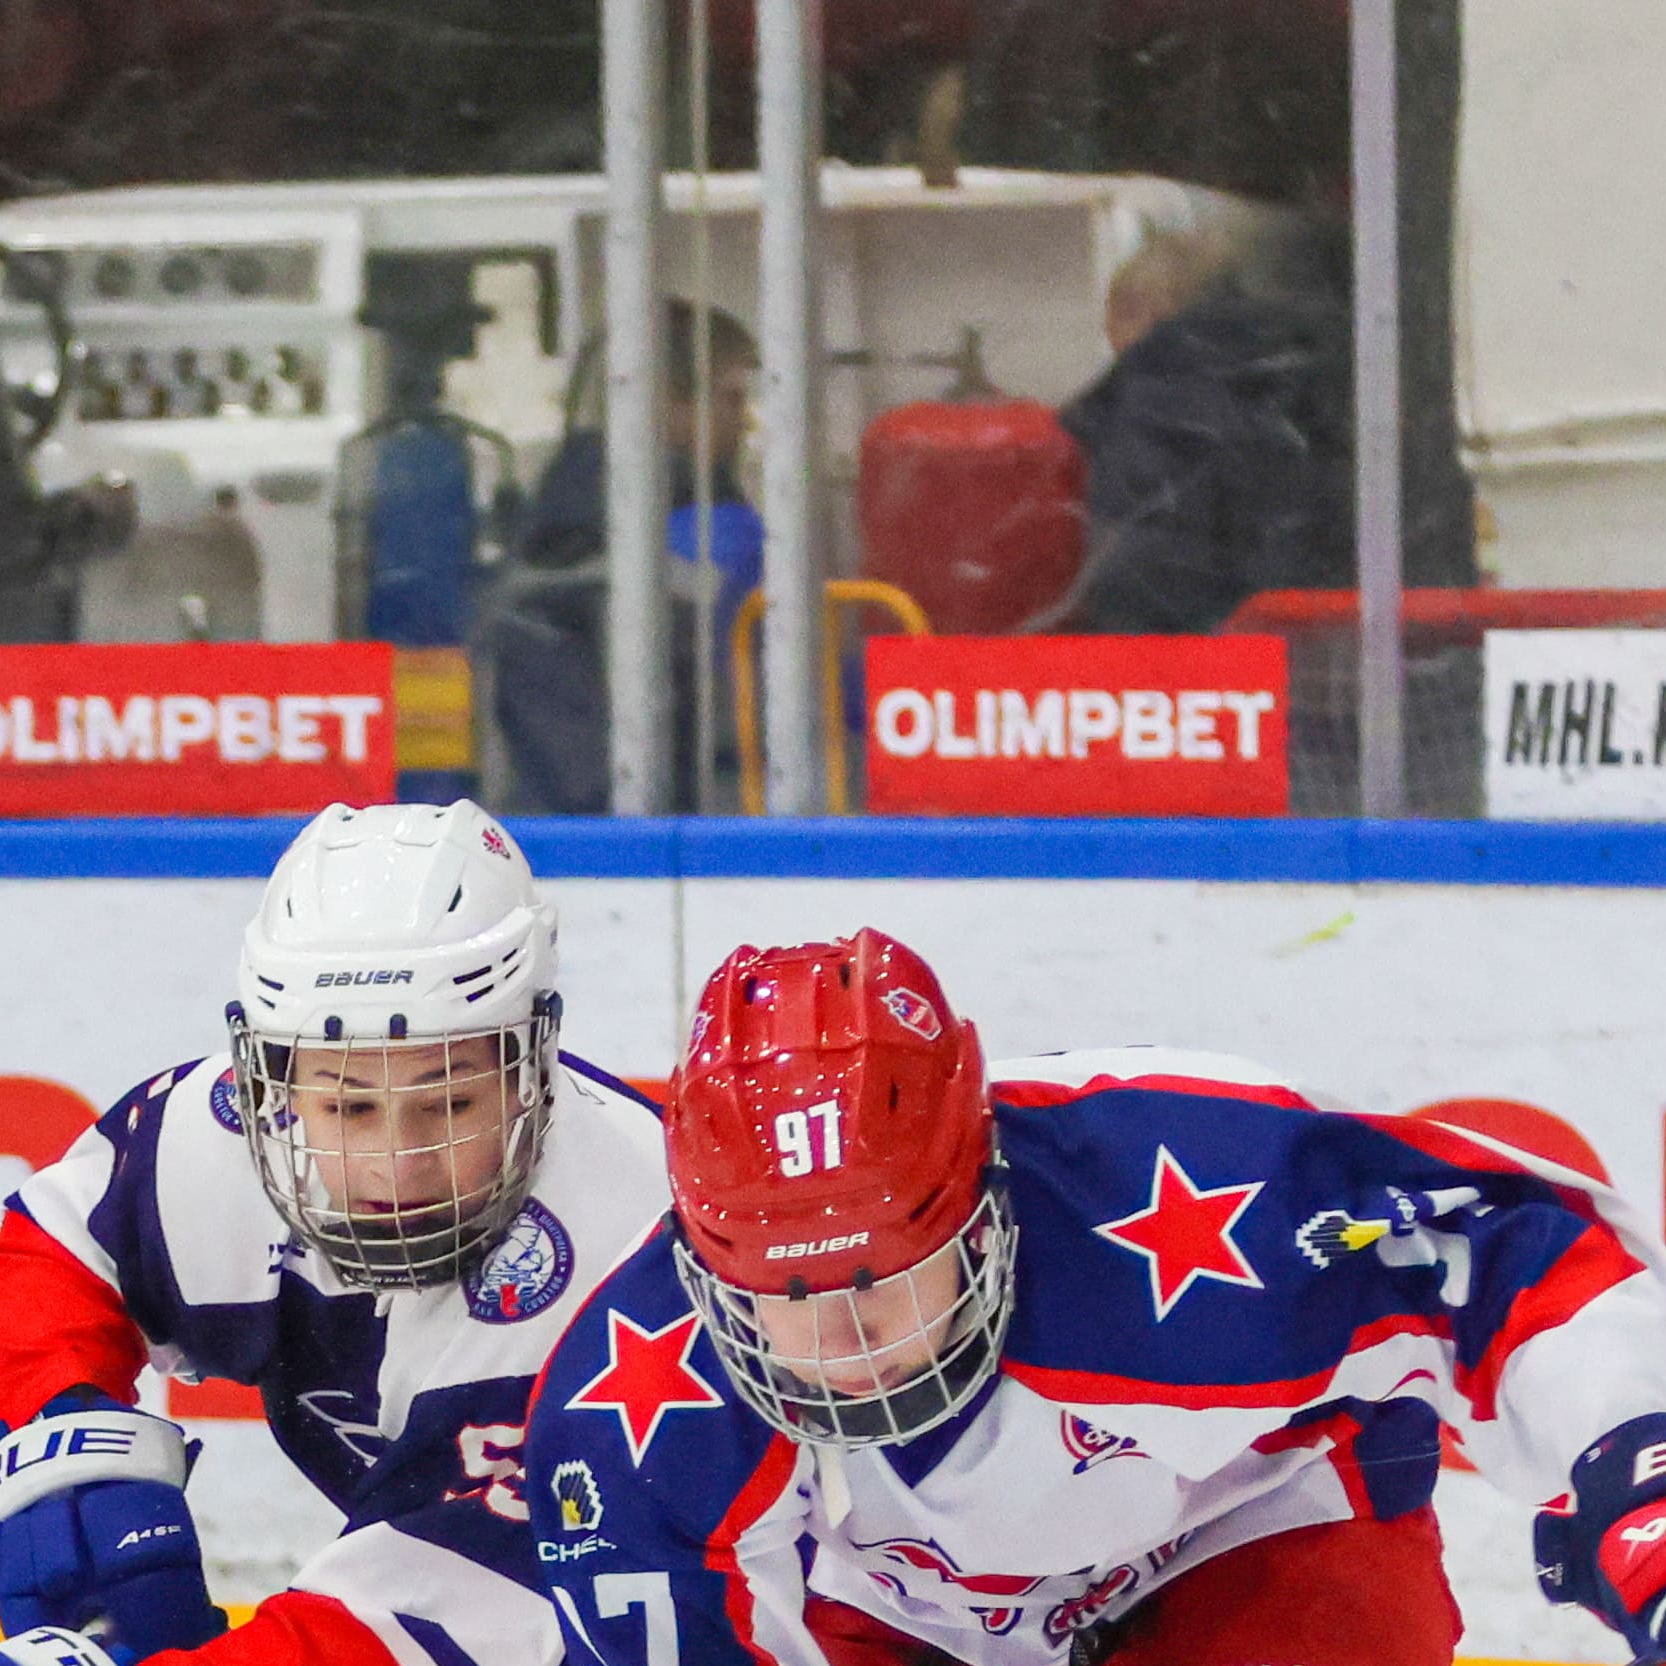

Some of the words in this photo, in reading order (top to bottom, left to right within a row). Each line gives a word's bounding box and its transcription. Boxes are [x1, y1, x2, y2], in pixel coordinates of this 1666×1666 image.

[875, 688, 1275, 760] OLIMPBET
[774, 1099, 843, 1179] 97
[765, 1230, 870, 1261] BAUER
